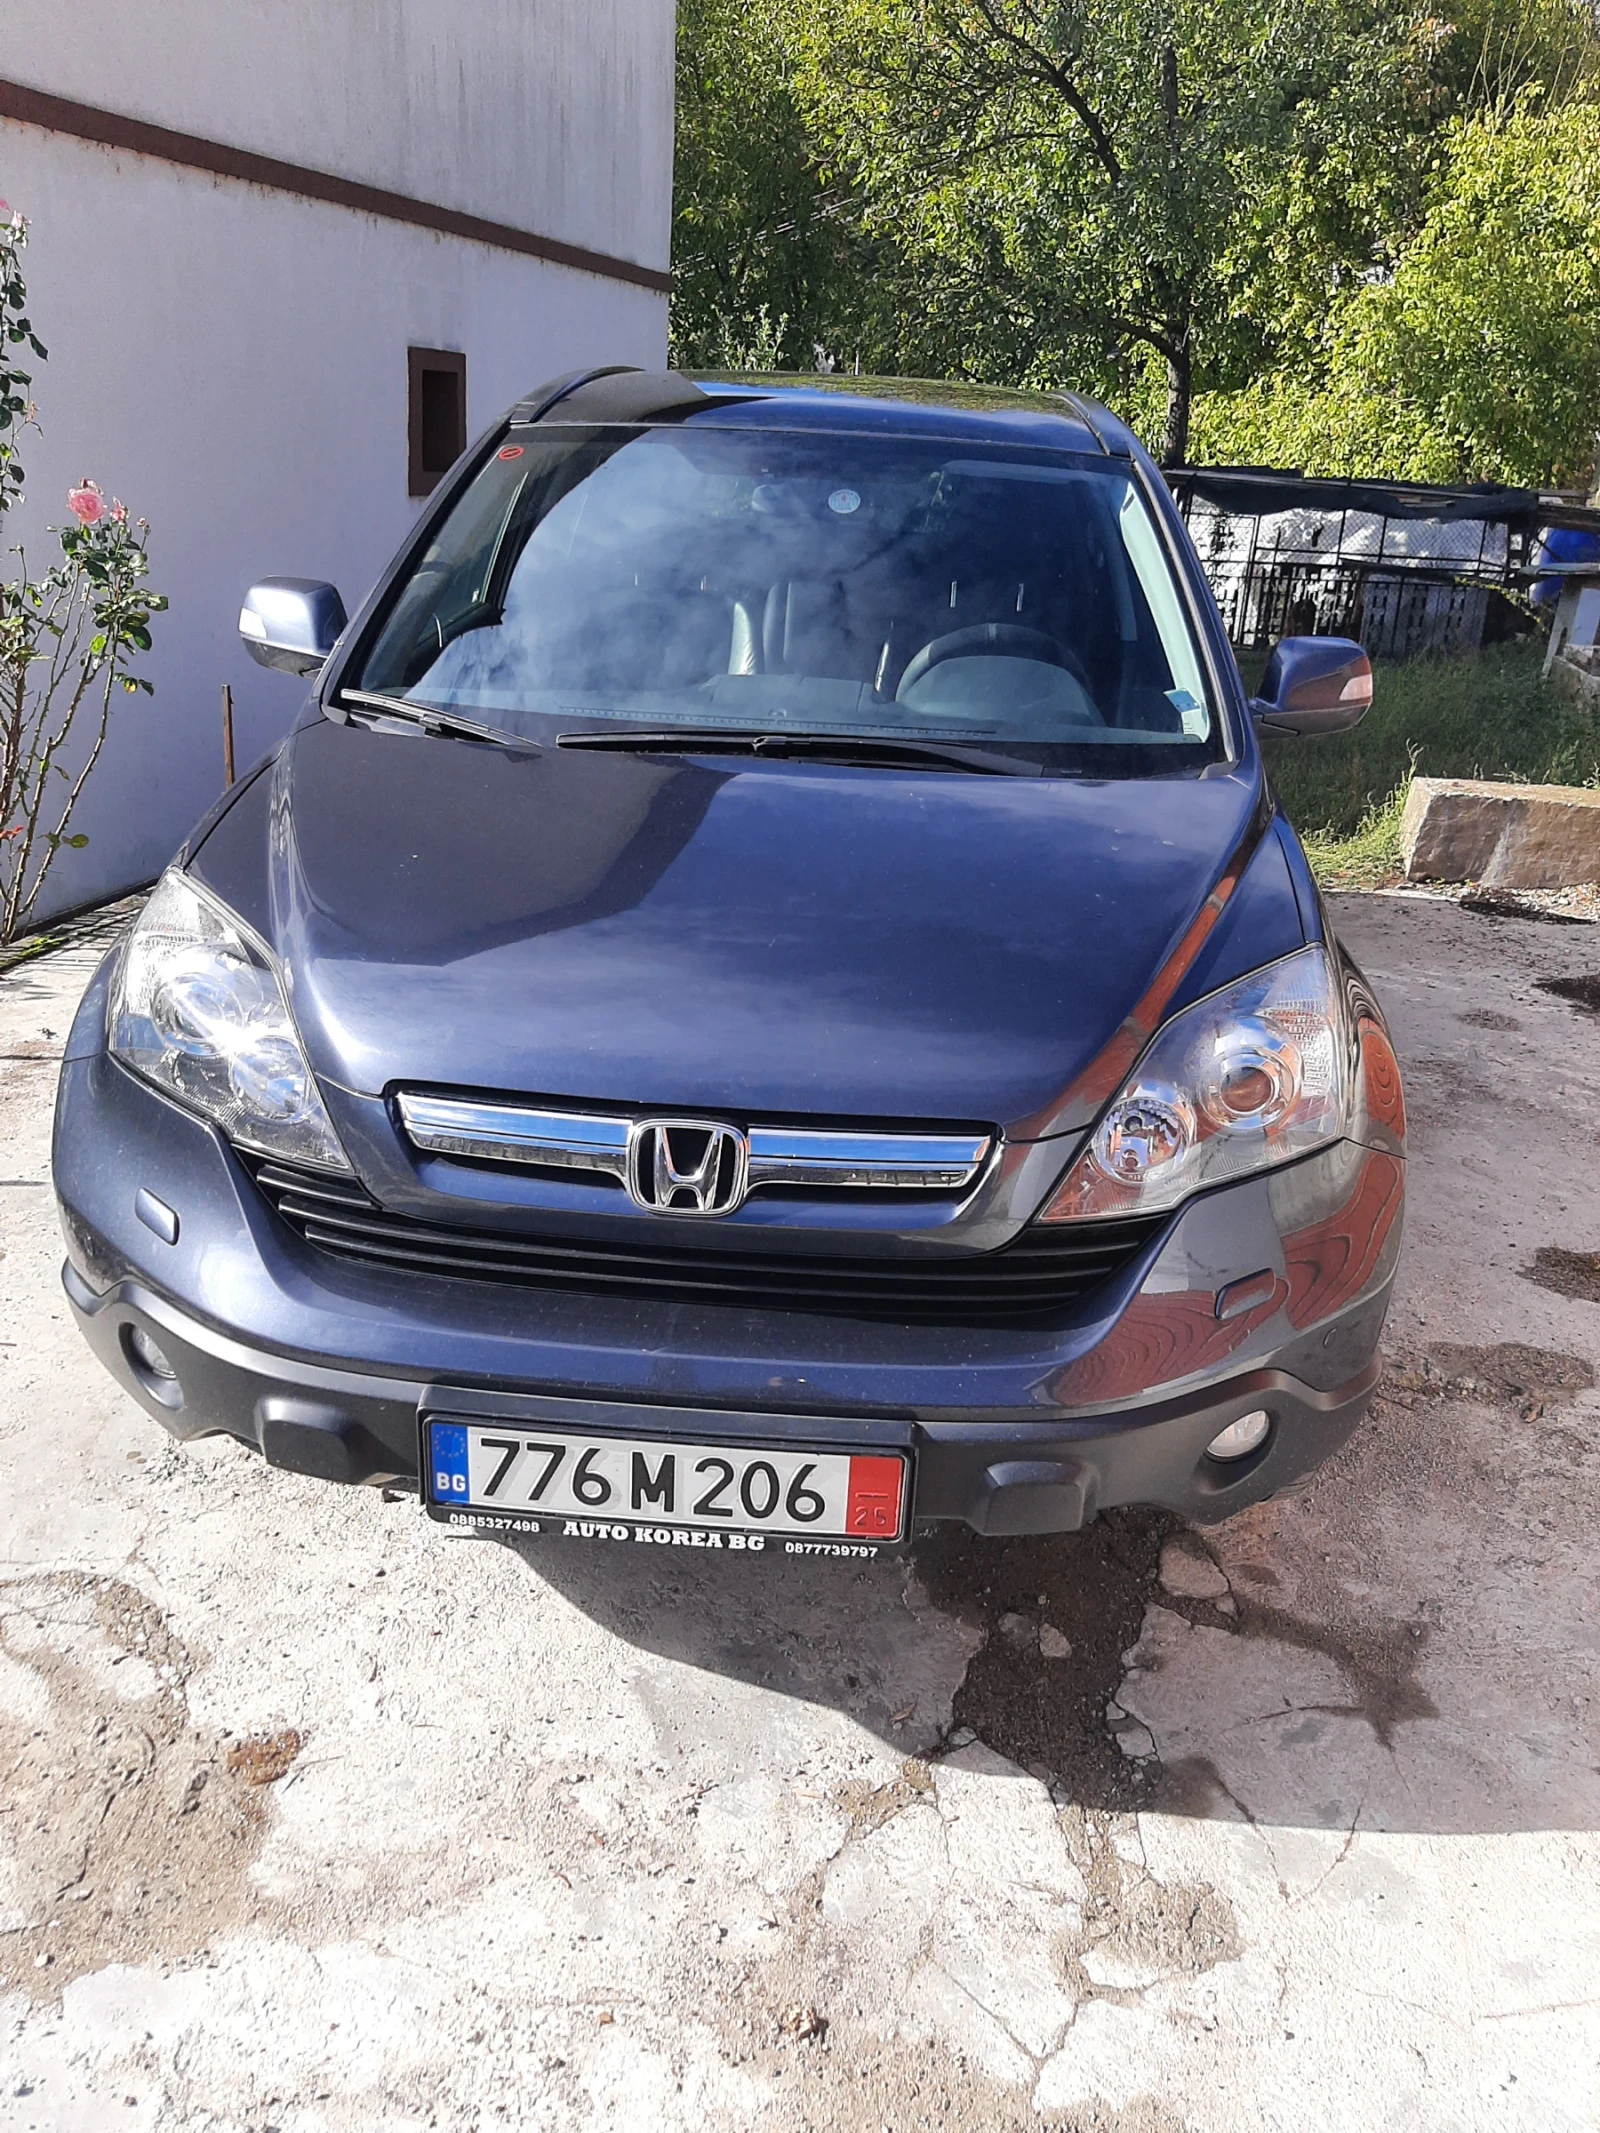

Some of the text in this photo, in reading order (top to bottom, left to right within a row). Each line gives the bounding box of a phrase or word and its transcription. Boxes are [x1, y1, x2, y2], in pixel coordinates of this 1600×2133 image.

[436, 1472, 466, 1492] BG
[480, 1438, 826, 1522] 776 M 206
[449, 1512, 541, 1533] 0885327498
[854, 1506, 887, 1526] 25
[562, 1520, 765, 1551] AUTO KOREA BG
[785, 1541, 879, 1558] 0877739797
